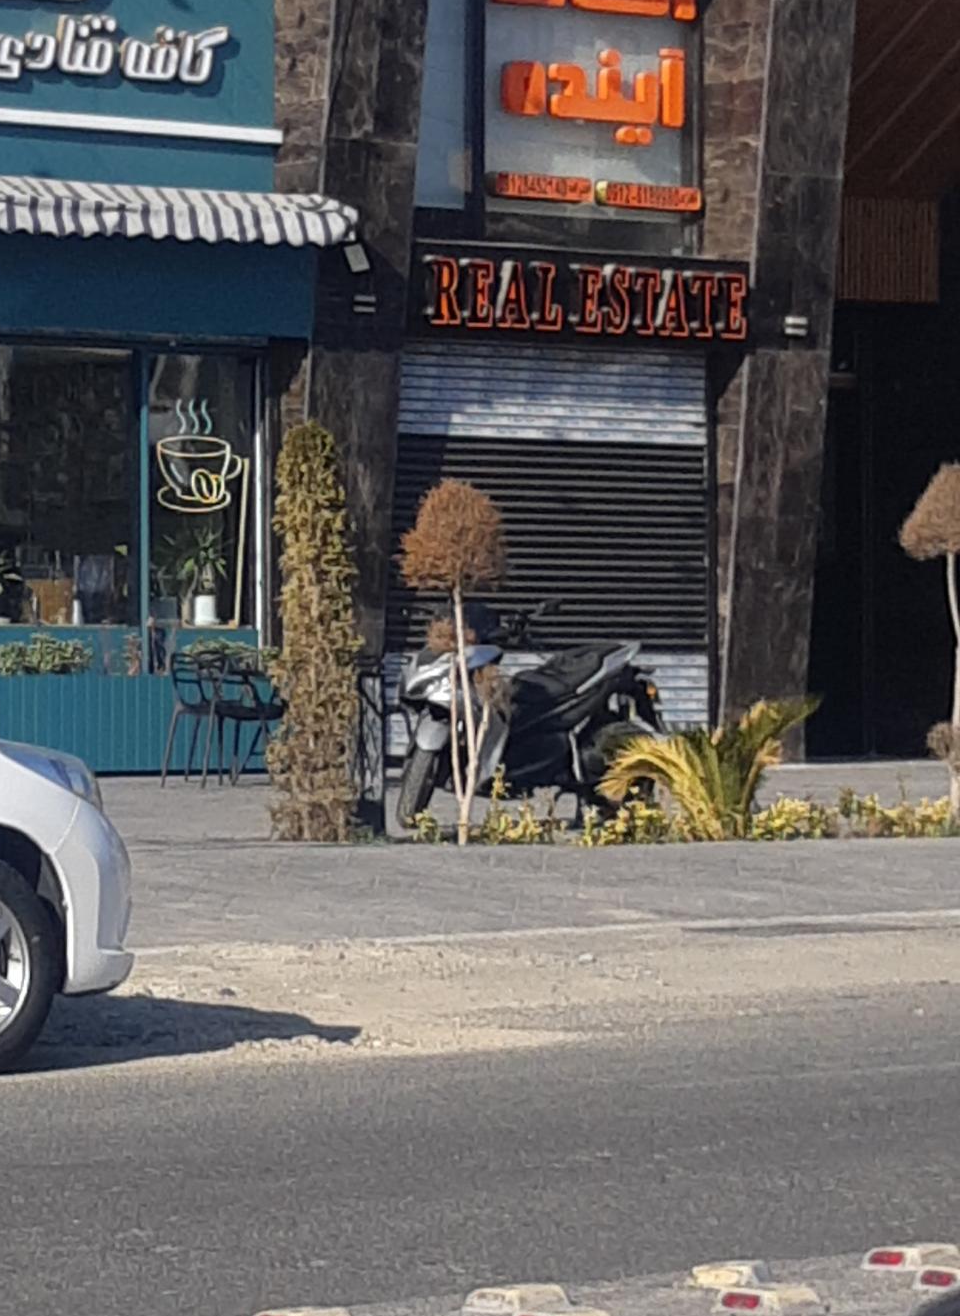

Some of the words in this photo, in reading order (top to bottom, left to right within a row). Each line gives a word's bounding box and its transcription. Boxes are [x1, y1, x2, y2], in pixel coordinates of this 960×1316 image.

[120, 25, 229, 83] کافه
[500, 47, 686, 146] آینده
[422, 254, 562, 332] REAL
[569, 263, 747, 340] ESTATE
